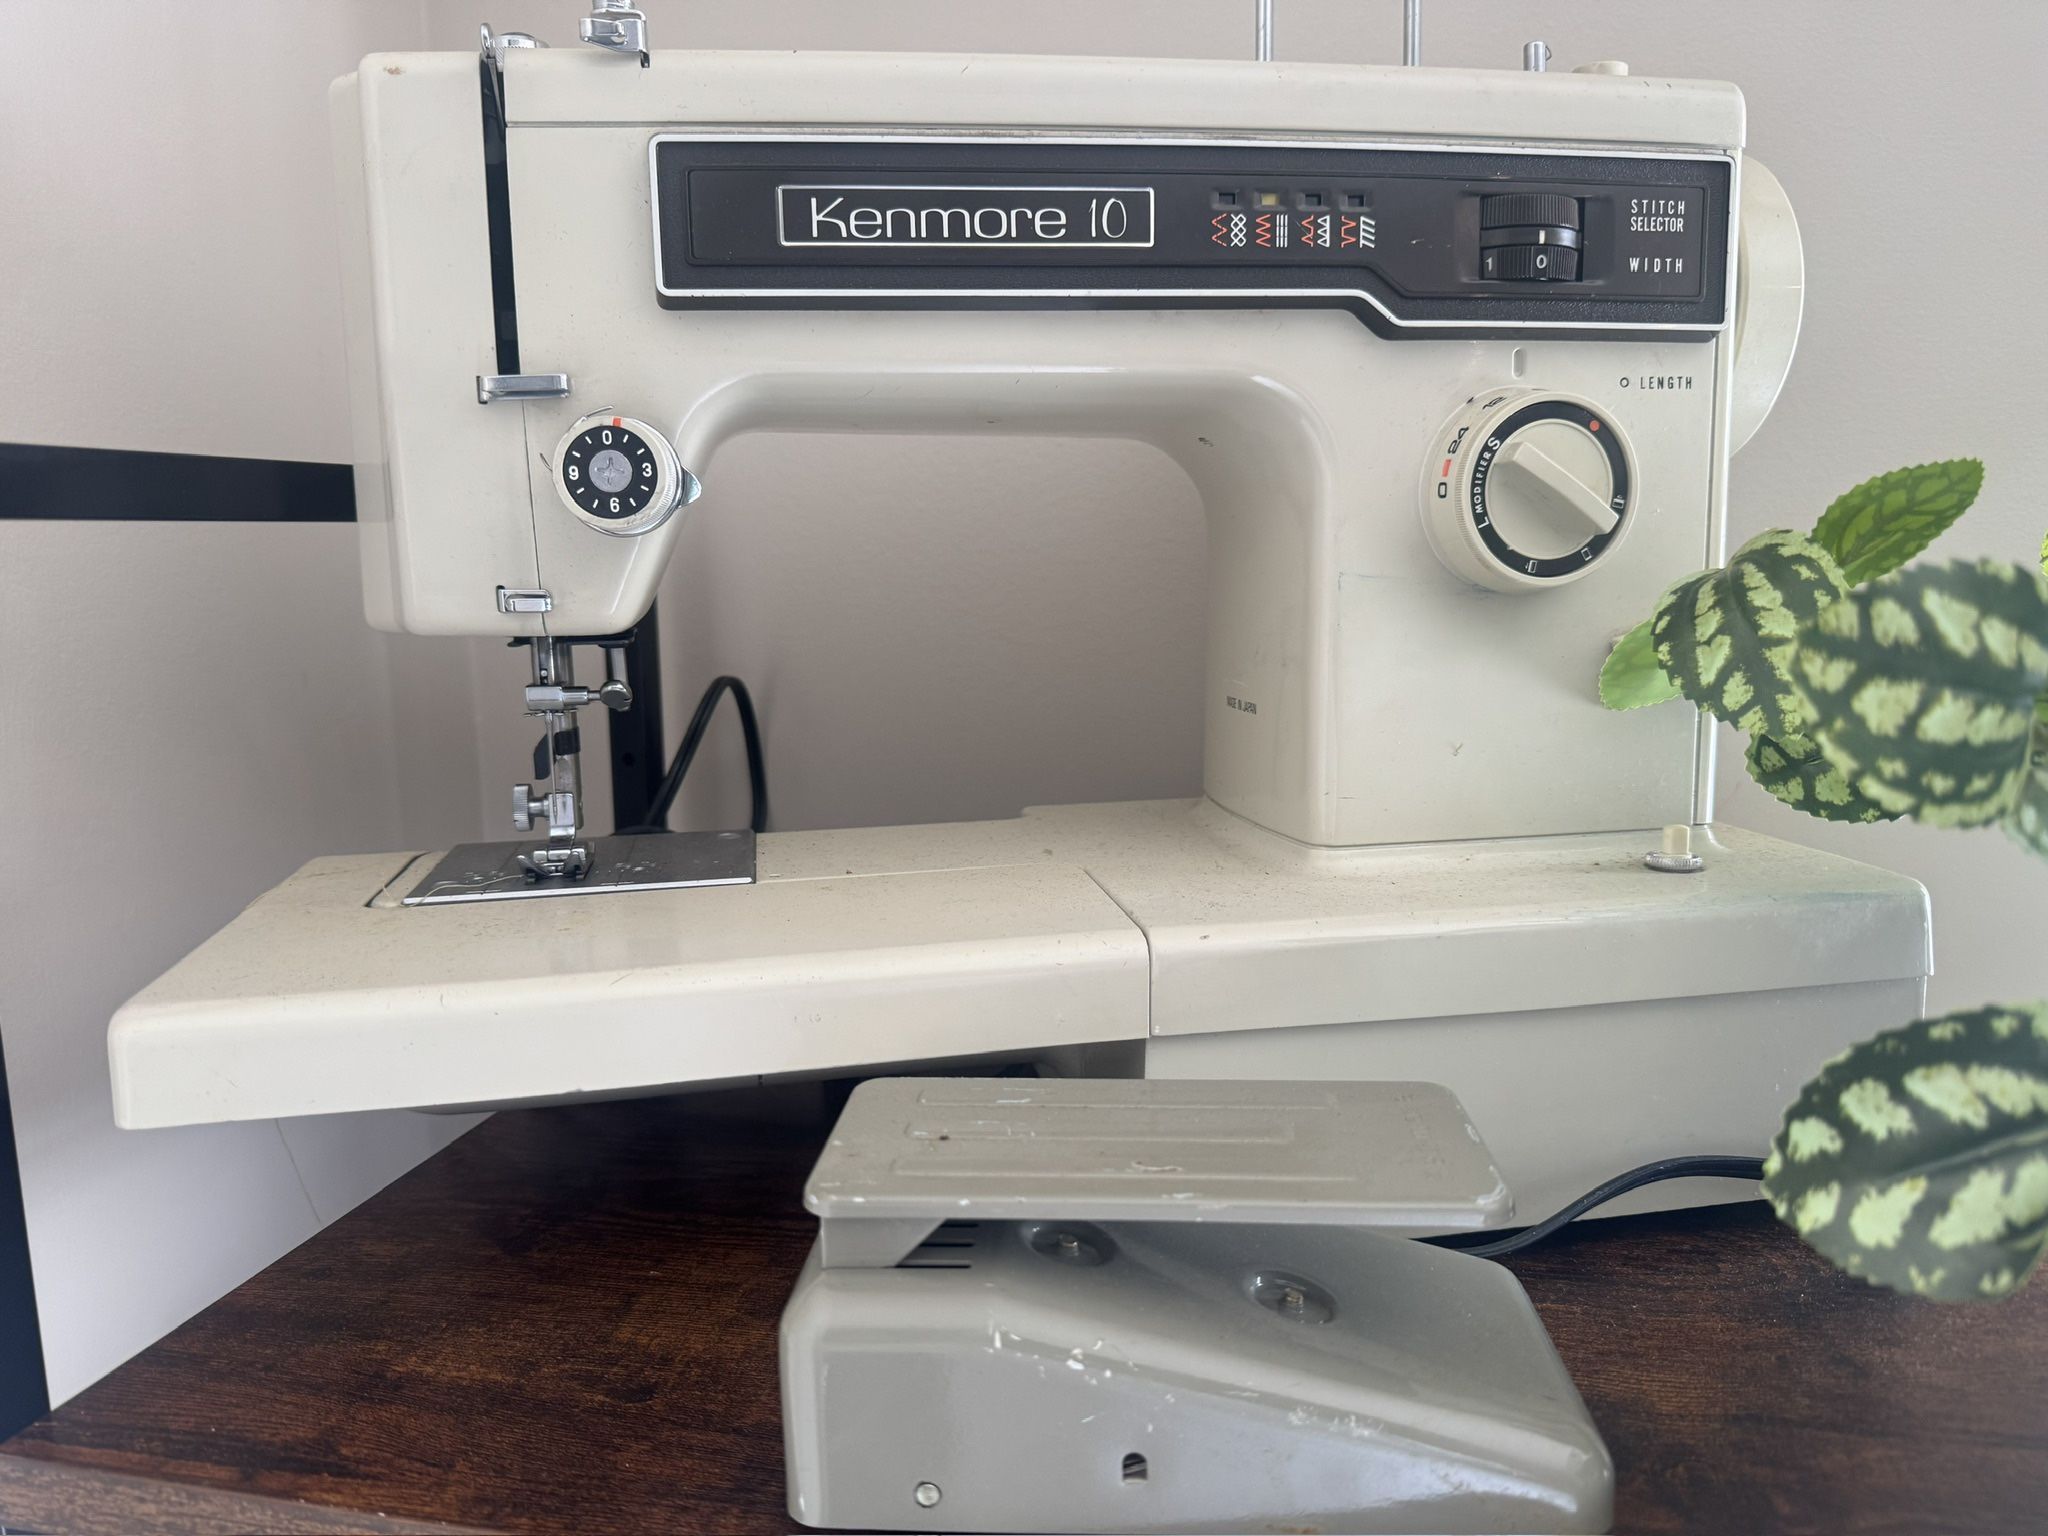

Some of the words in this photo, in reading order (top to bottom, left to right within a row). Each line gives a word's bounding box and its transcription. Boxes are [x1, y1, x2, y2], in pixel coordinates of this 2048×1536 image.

[1630, 199, 1685, 215] STITCH
[811, 197, 1067, 239] Kenmore
[1088, 197, 1127, 239] 10
[1630, 216, 1684, 233] SELECTOR
[1485, 257, 1493, 271] 1
[1536, 254, 1547, 269] 0
[1629, 257, 1683, 273] WIDTH
[1640, 376, 1693, 390] LENGTH
[602, 430, 613, 445] 0
[1487, 437, 1501, 450] S
[568, 465, 579, 481] 9
[641, 462, 653, 478] 3
[1438, 482, 1448, 499] 0
[1473, 451, 1492, 514] MODIFIER
[609, 497, 620, 513] 6
[1477, 516, 1490, 529] L
